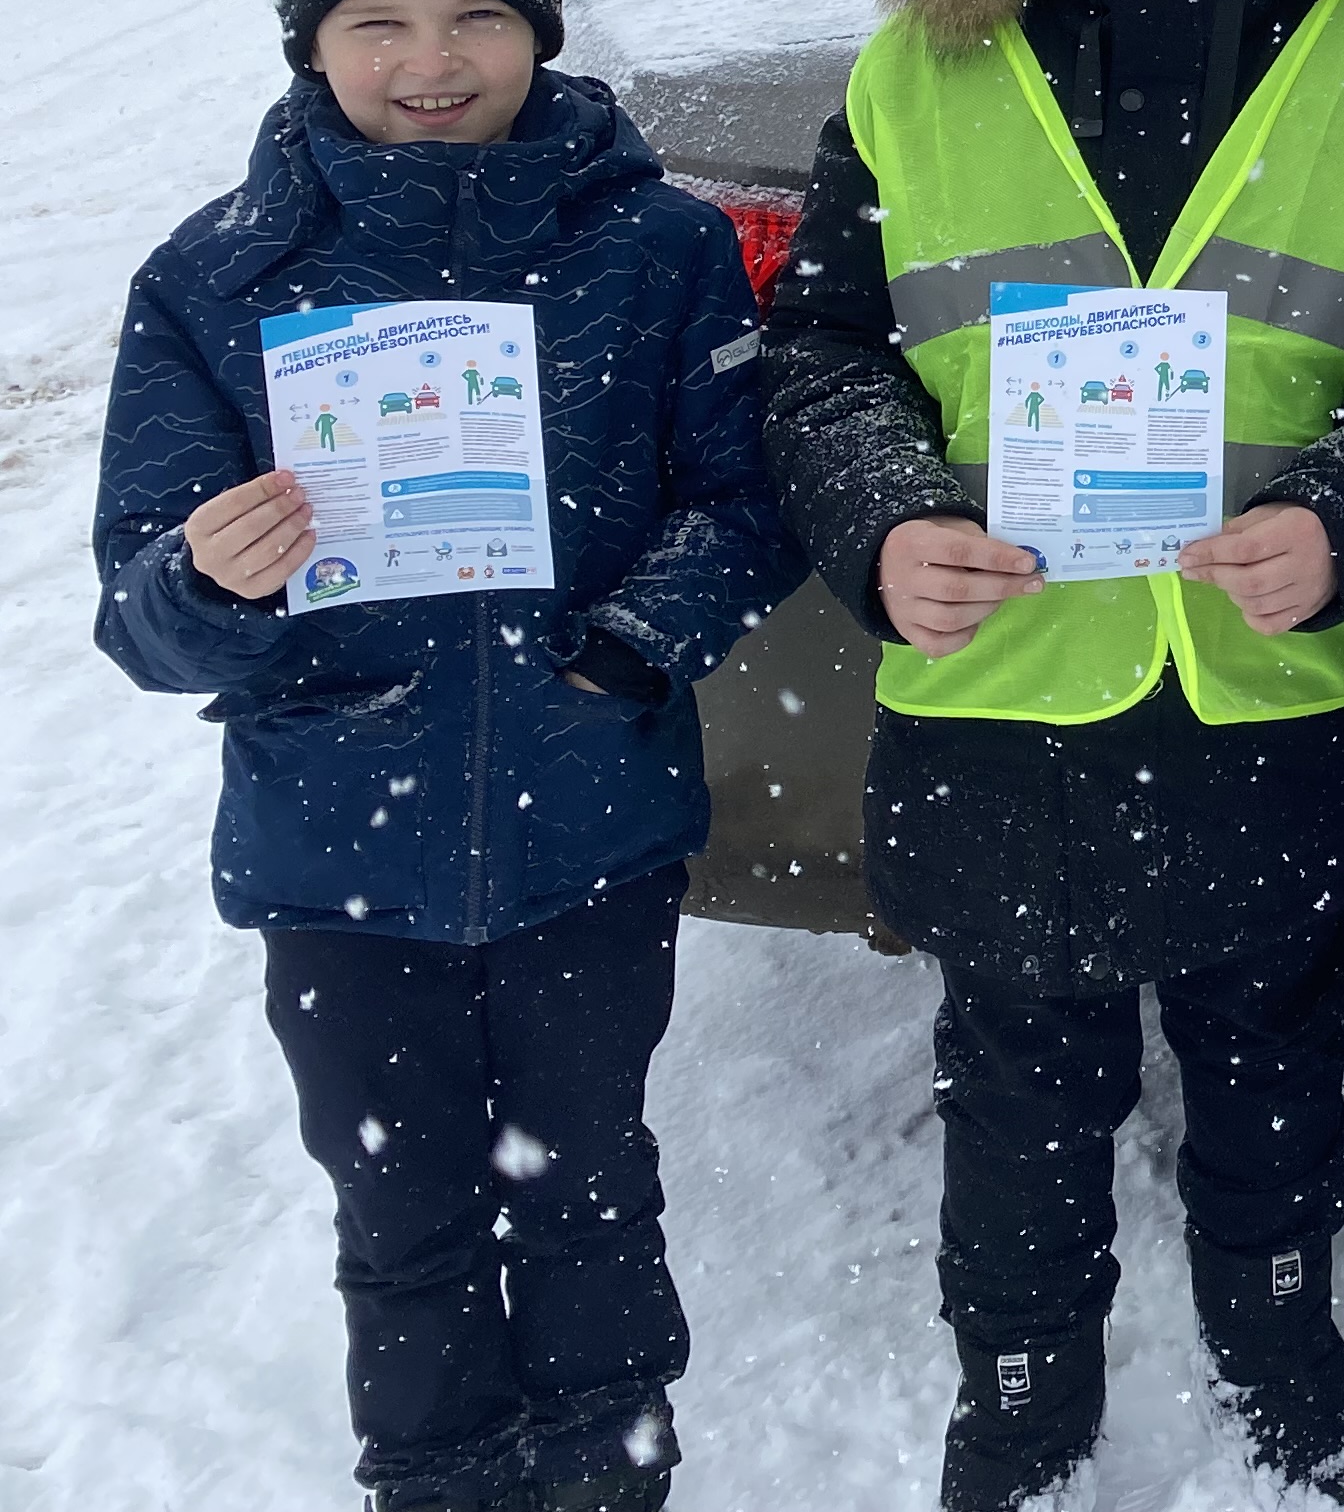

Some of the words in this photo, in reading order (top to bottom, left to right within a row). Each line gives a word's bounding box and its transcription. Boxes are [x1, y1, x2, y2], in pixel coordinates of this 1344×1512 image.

[281, 332, 374, 365] ПЕШЕХОДЫ,
[377, 314, 472, 340] ДВИГАЙТЕСЬ
[997, 313, 1186, 348] #НАВСТРЕЧУБЕЗОПАСНОСТИ!
[1005, 314, 1084, 334] ПЕШЕХОДЫ,
[1086, 303, 1170, 325] ДВИГАЙТЕСЬ
[273, 323, 491, 380] #НАВСТРЕЧУБЕЗОПАСНОСТИ!
